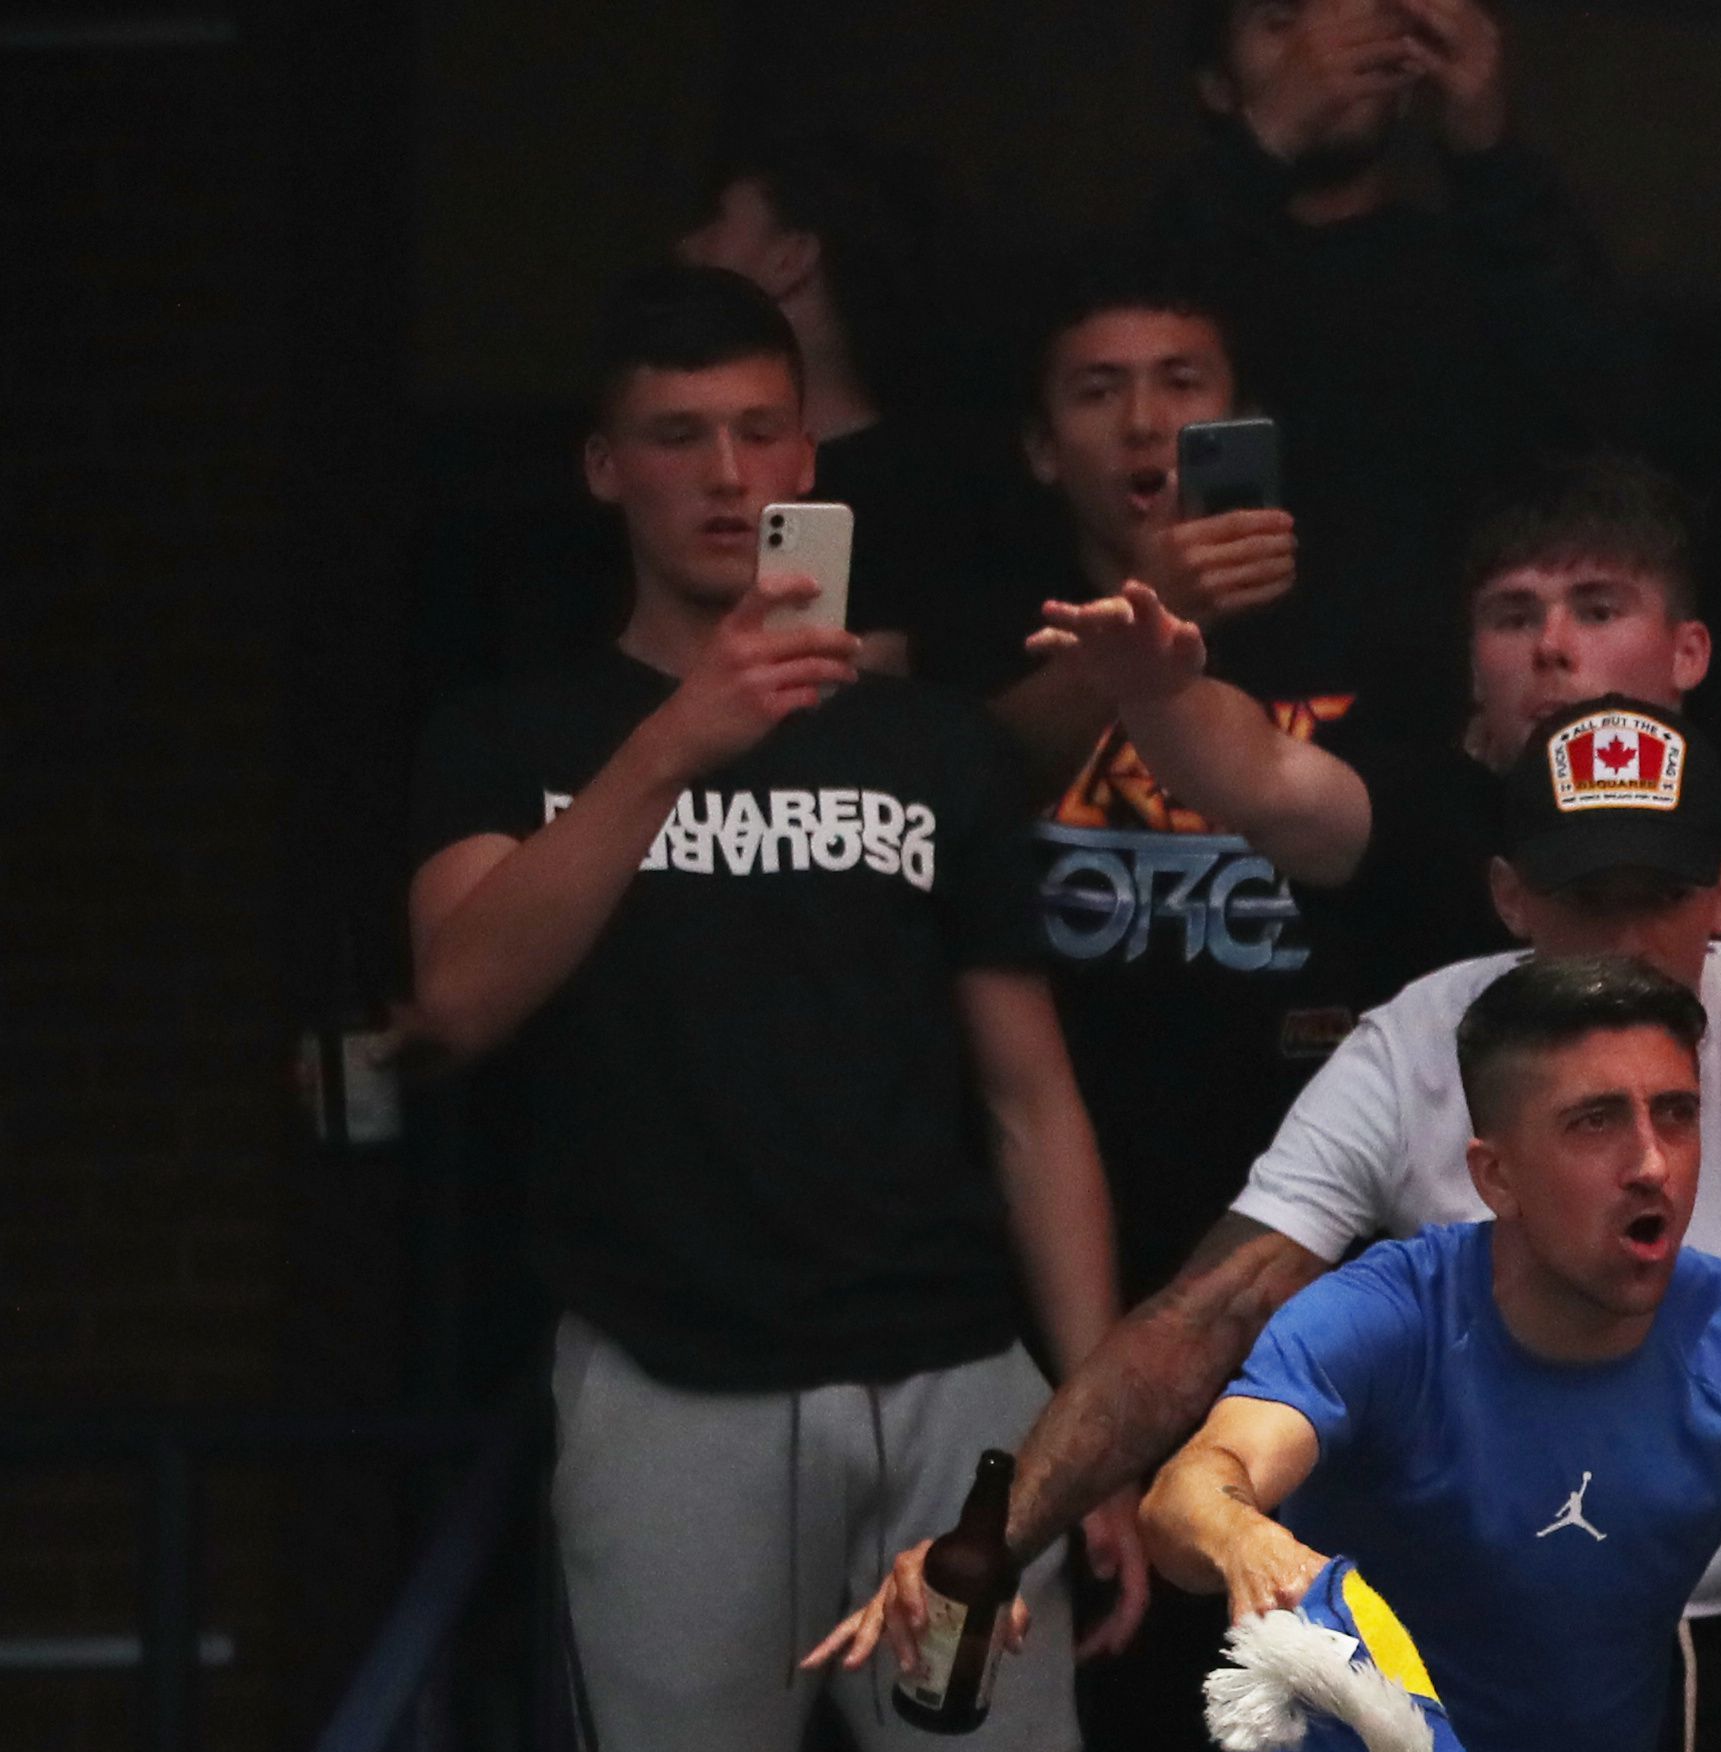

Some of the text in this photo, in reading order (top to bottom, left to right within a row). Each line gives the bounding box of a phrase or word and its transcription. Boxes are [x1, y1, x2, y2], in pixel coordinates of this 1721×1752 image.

[1573, 720, 1597, 735] ALL
[1601, 716, 1627, 727] BUT
[1633, 720, 1659, 733] THE
